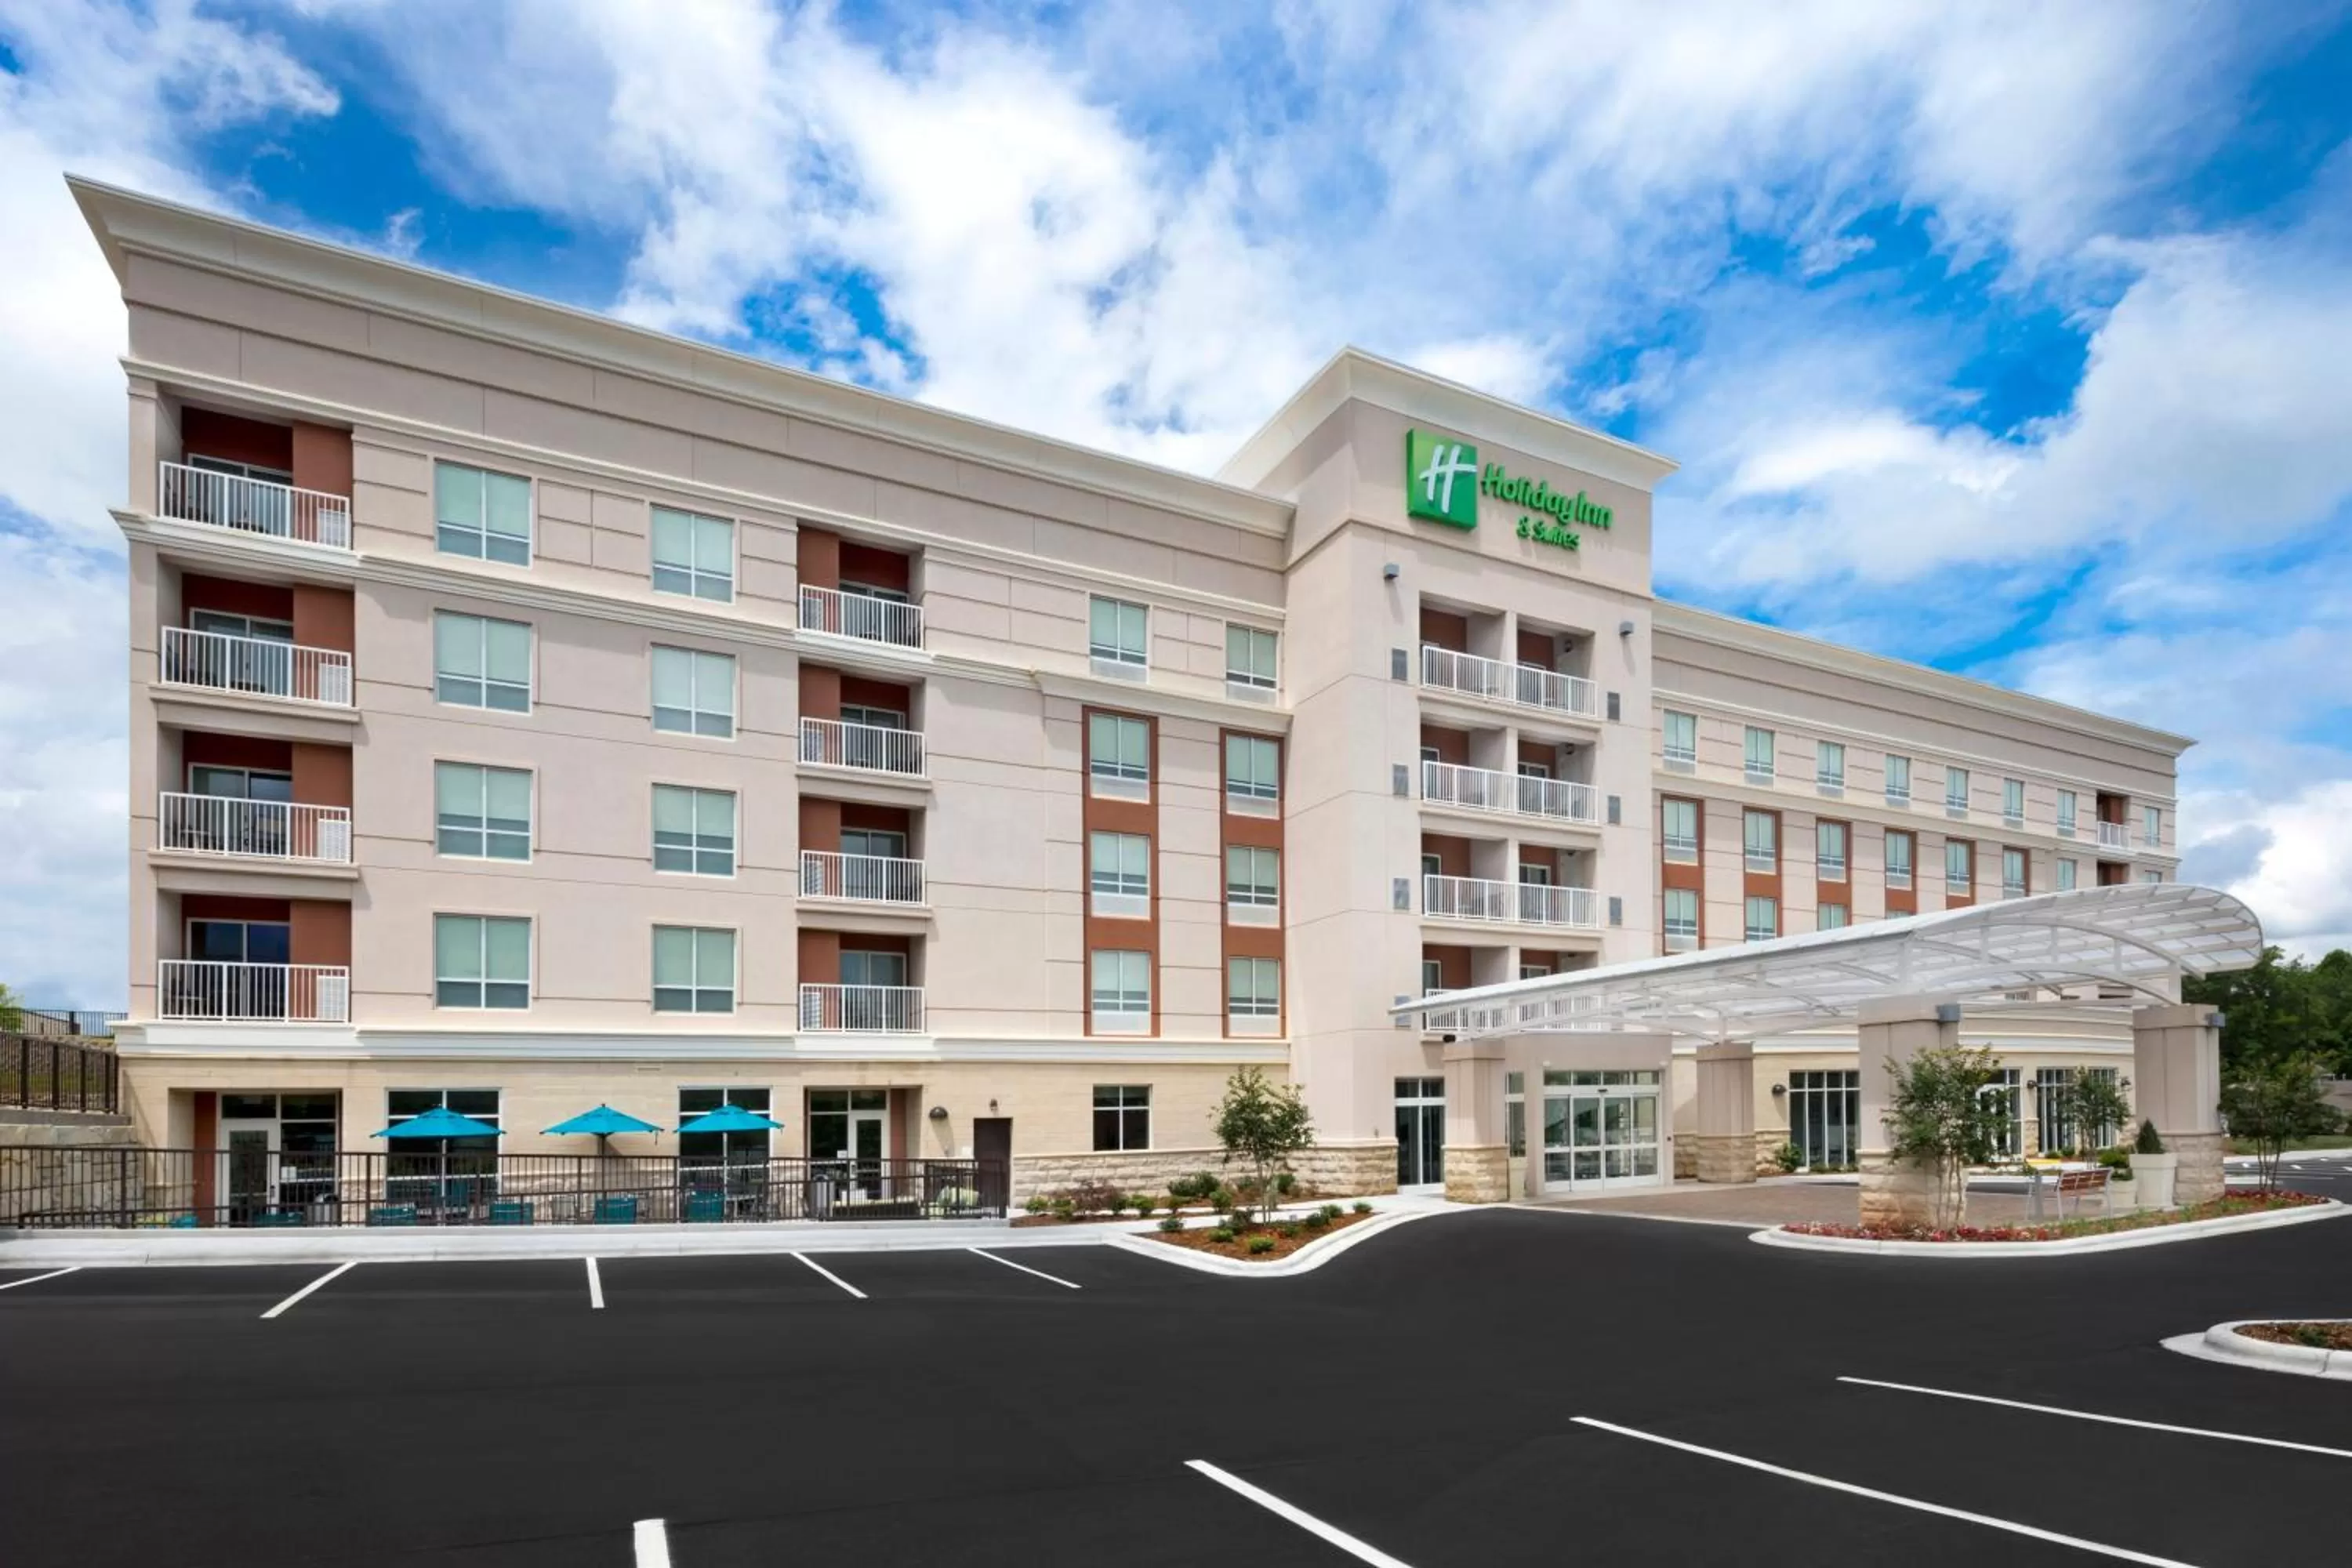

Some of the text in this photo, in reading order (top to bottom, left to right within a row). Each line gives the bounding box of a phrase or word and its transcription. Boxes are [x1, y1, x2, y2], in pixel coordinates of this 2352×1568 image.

[1419, 445, 1477, 514] H
[1481, 463, 1613, 528] Holiday Inn
[1516, 516, 1579, 550] & Suites
